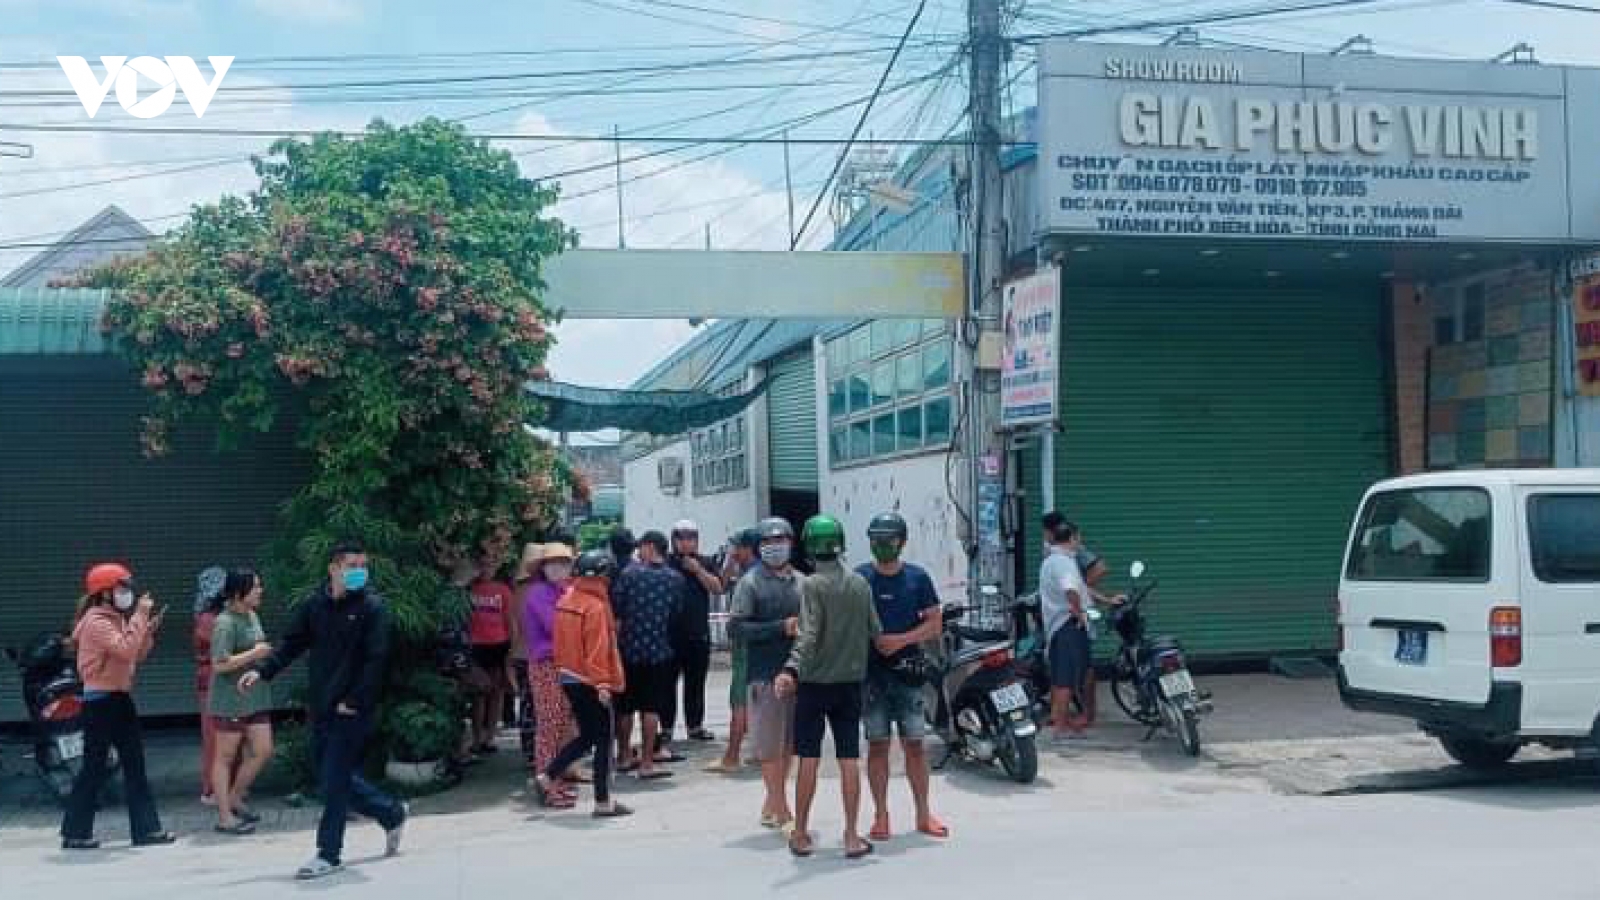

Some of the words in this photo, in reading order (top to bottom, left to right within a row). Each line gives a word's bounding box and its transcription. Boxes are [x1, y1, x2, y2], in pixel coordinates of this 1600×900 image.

[1105, 58, 1244, 84] SHOWROOM
[1120, 93, 1221, 149] GIA
[1235, 82, 1392, 156] PHÚC
[1402, 105, 1538, 161] VINH
[1058, 154, 1153, 171] CHUYN
[1439, 166, 1484, 181] CAO
